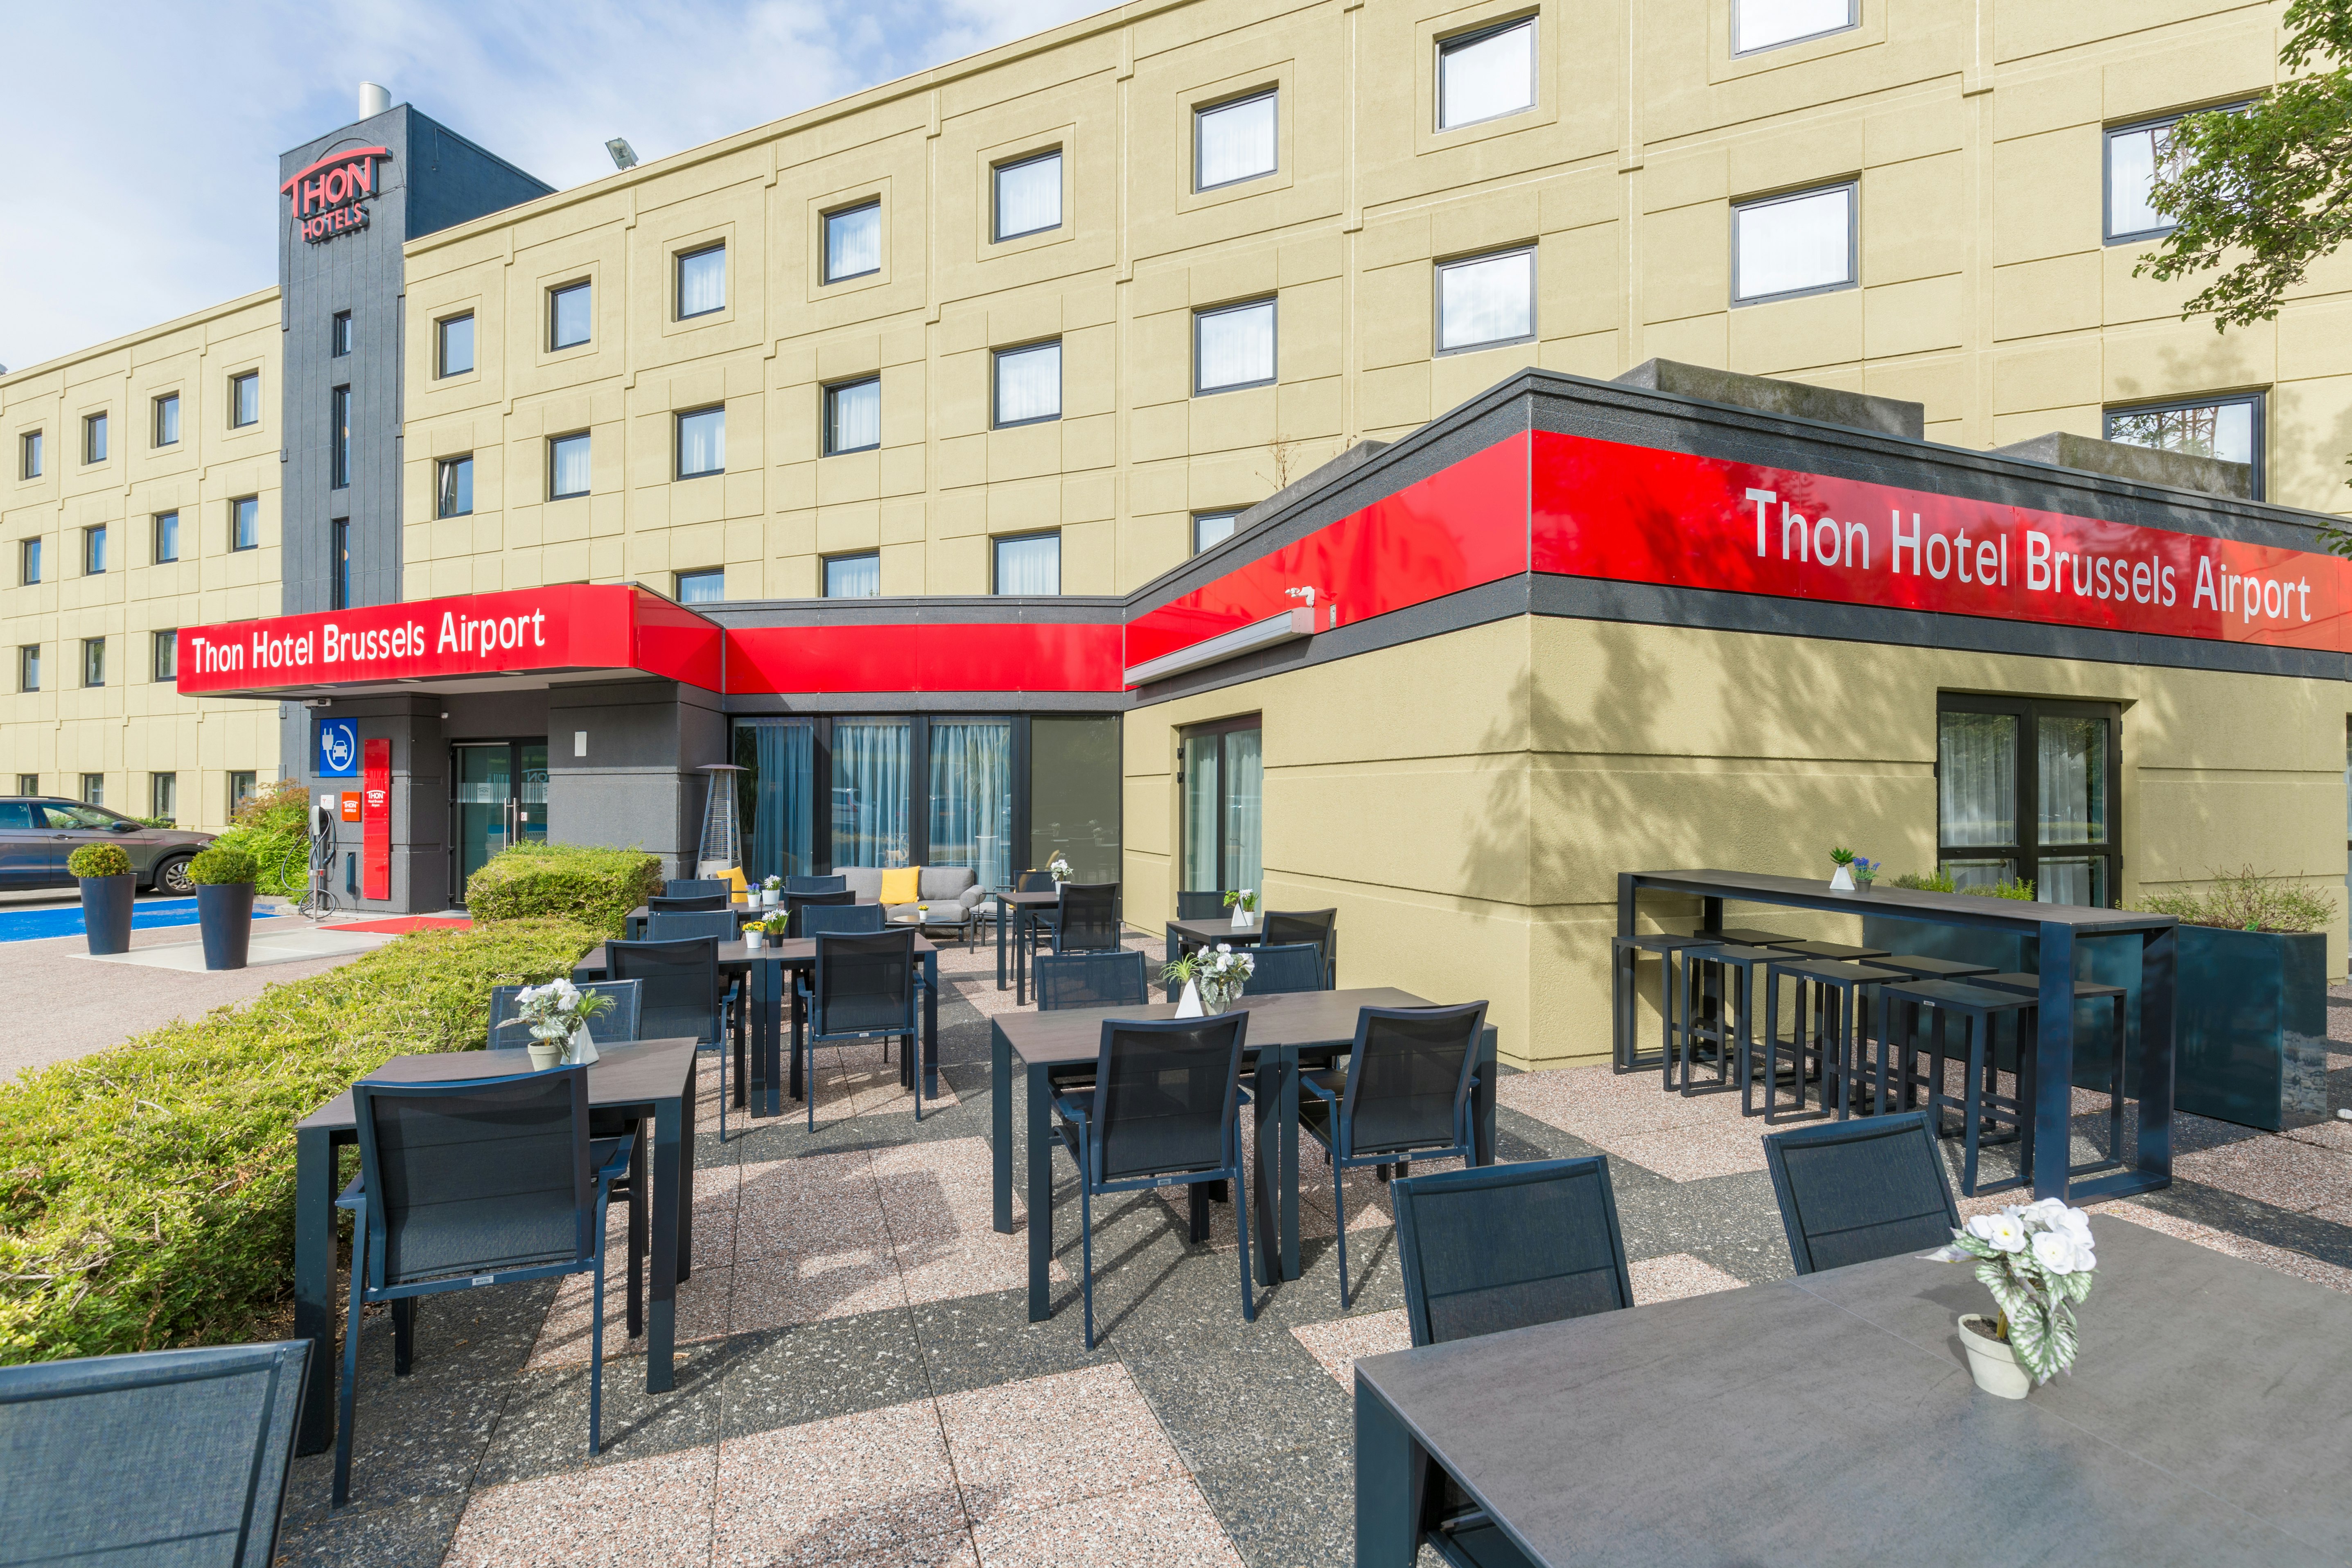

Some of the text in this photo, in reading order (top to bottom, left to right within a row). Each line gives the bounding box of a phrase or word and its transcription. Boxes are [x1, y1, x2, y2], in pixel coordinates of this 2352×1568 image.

[281, 147, 386, 218] THON
[302, 203, 363, 241] HOTELS
[1746, 488, 2311, 624] Thon Hotel Brussels Airport
[192, 607, 545, 673] Thon Hotel Brussels Airport
[366, 790, 386, 799] THON
